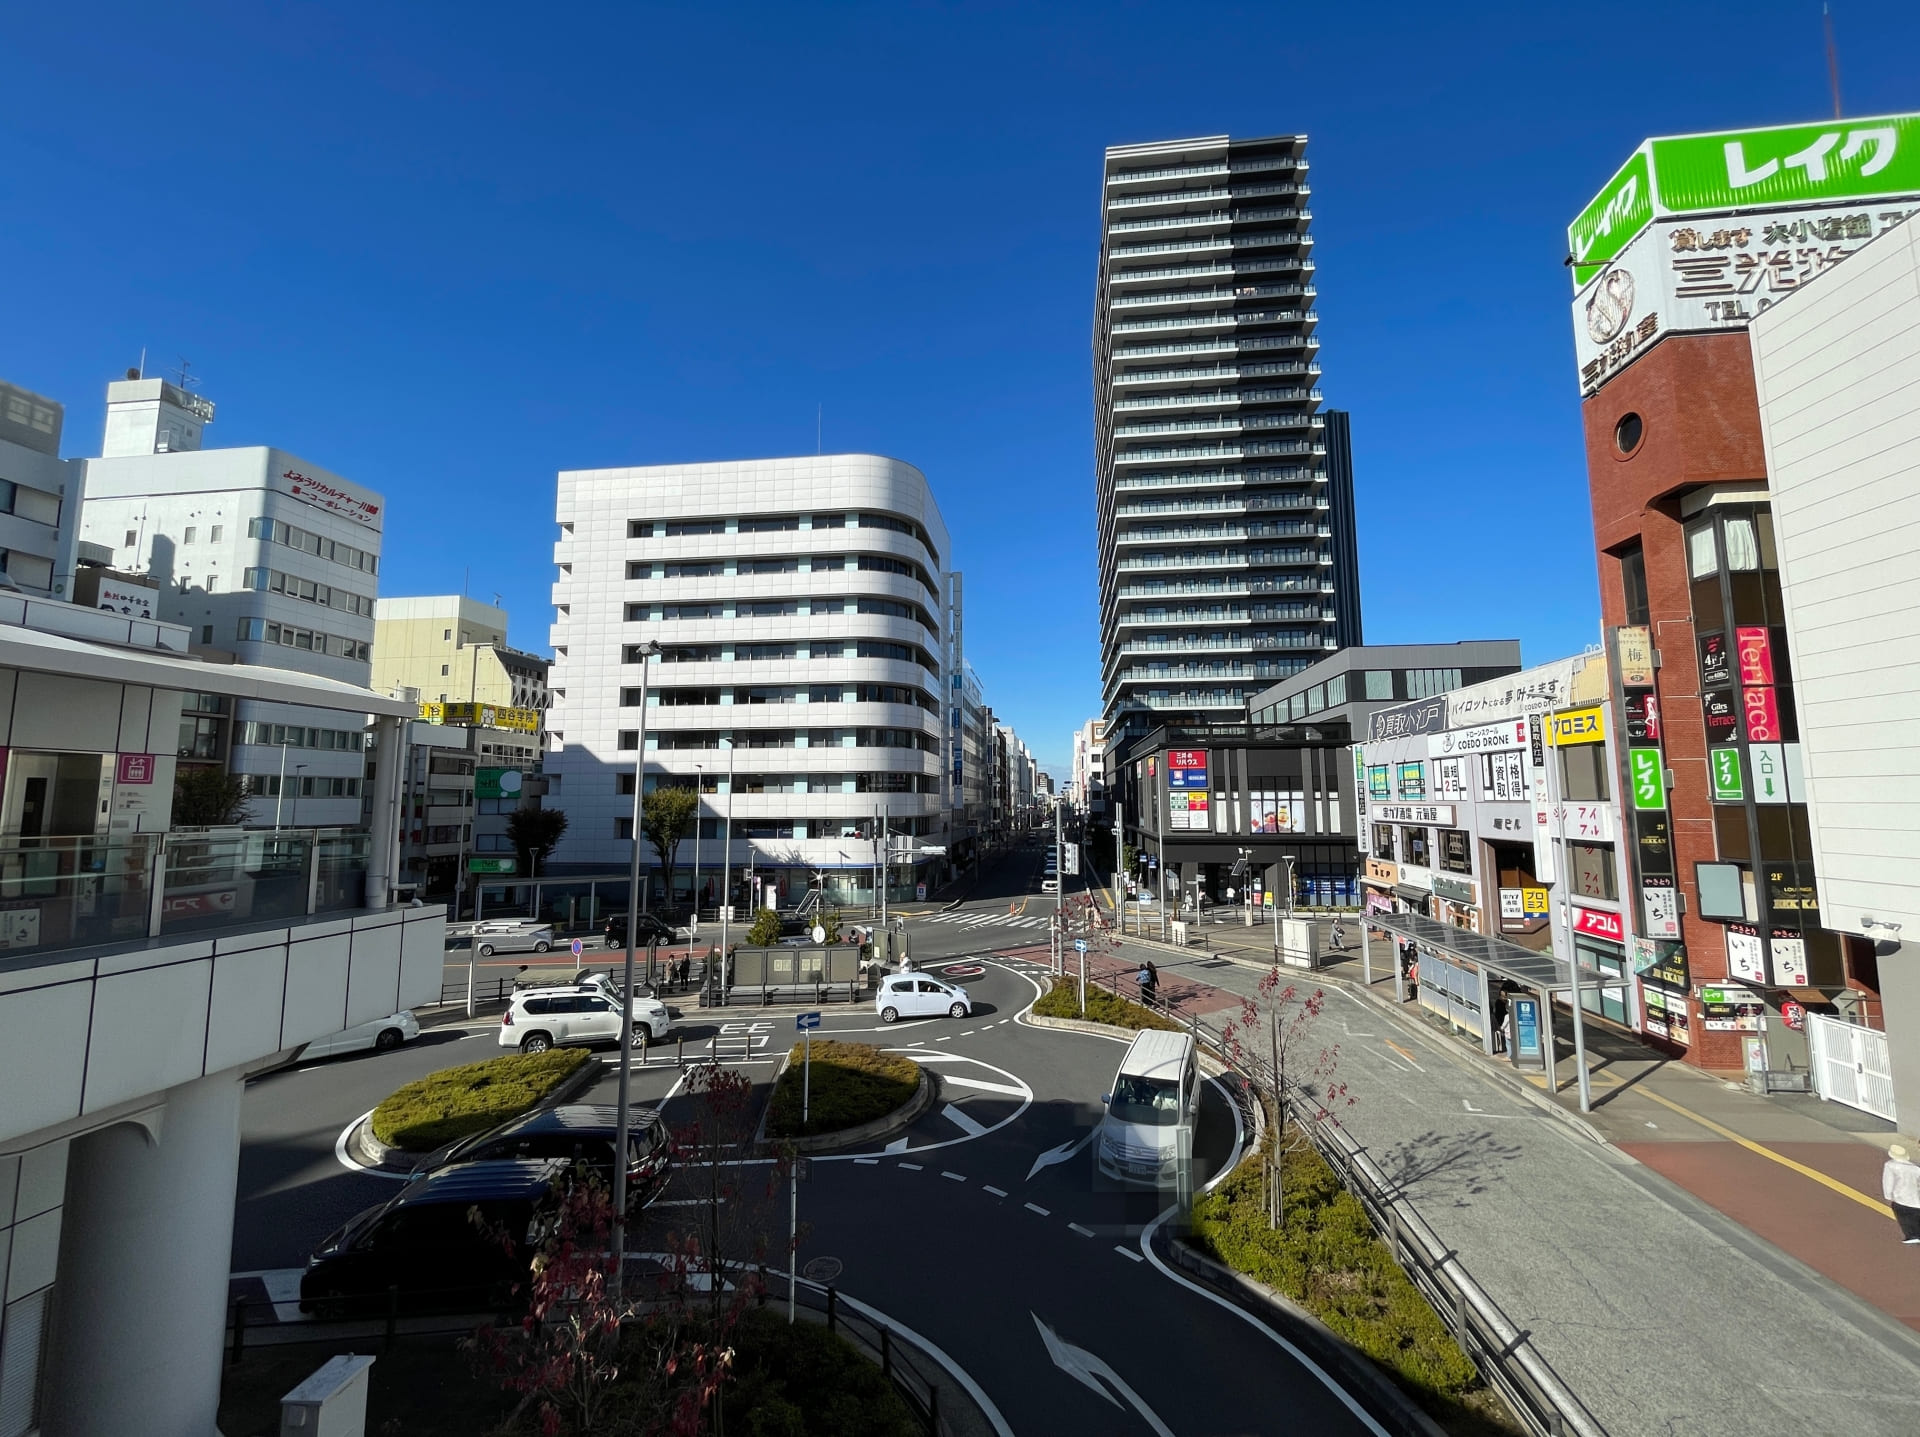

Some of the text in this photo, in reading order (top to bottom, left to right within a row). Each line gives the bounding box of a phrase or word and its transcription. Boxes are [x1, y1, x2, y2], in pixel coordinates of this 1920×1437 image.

[1724, 127, 1897, 189] レイク
[1575, 174, 1638, 256] レイク
[1669, 227, 1753, 252] 貸します
[1762, 213, 1872, 246] 大小店舗
[1704, 300, 1750, 322] TEL
[1628, 647, 1642, 662] 梅
[1740, 628, 1770, 741] Terrace
[498, 708, 534, 724] 四谷学院
[1383, 703, 1441, 737] 買取小江戸
[1707, 715, 1736, 727] Terrace
[1549, 715, 1598, 738] プロミス
[1458, 734, 1510, 750] COEDO DRONE
[1719, 752, 1732, 786] レイク
[1760, 750, 1774, 774] 入口
[1496, 764, 1520, 781] 資格
[1636, 754, 1656, 800] レイク
[1445, 779, 1459, 792] 2日
[1496, 780, 1521, 798] 取得
[1578, 807, 1597, 820] アイ
[1579, 824, 1600, 836] フル
[1644, 878, 1671, 886] やきとり
[1770, 872, 1783, 881] 2F
[1526, 892, 1544, 900] プロ
[1527, 901, 1545, 909] ミス
[1645, 892, 1664, 921] いち
[1585, 913, 1619, 933] アコム
[1730, 924, 1757, 936] やきとり
[1731, 939, 1751, 972] いち
[1774, 945, 1794, 974] いち
